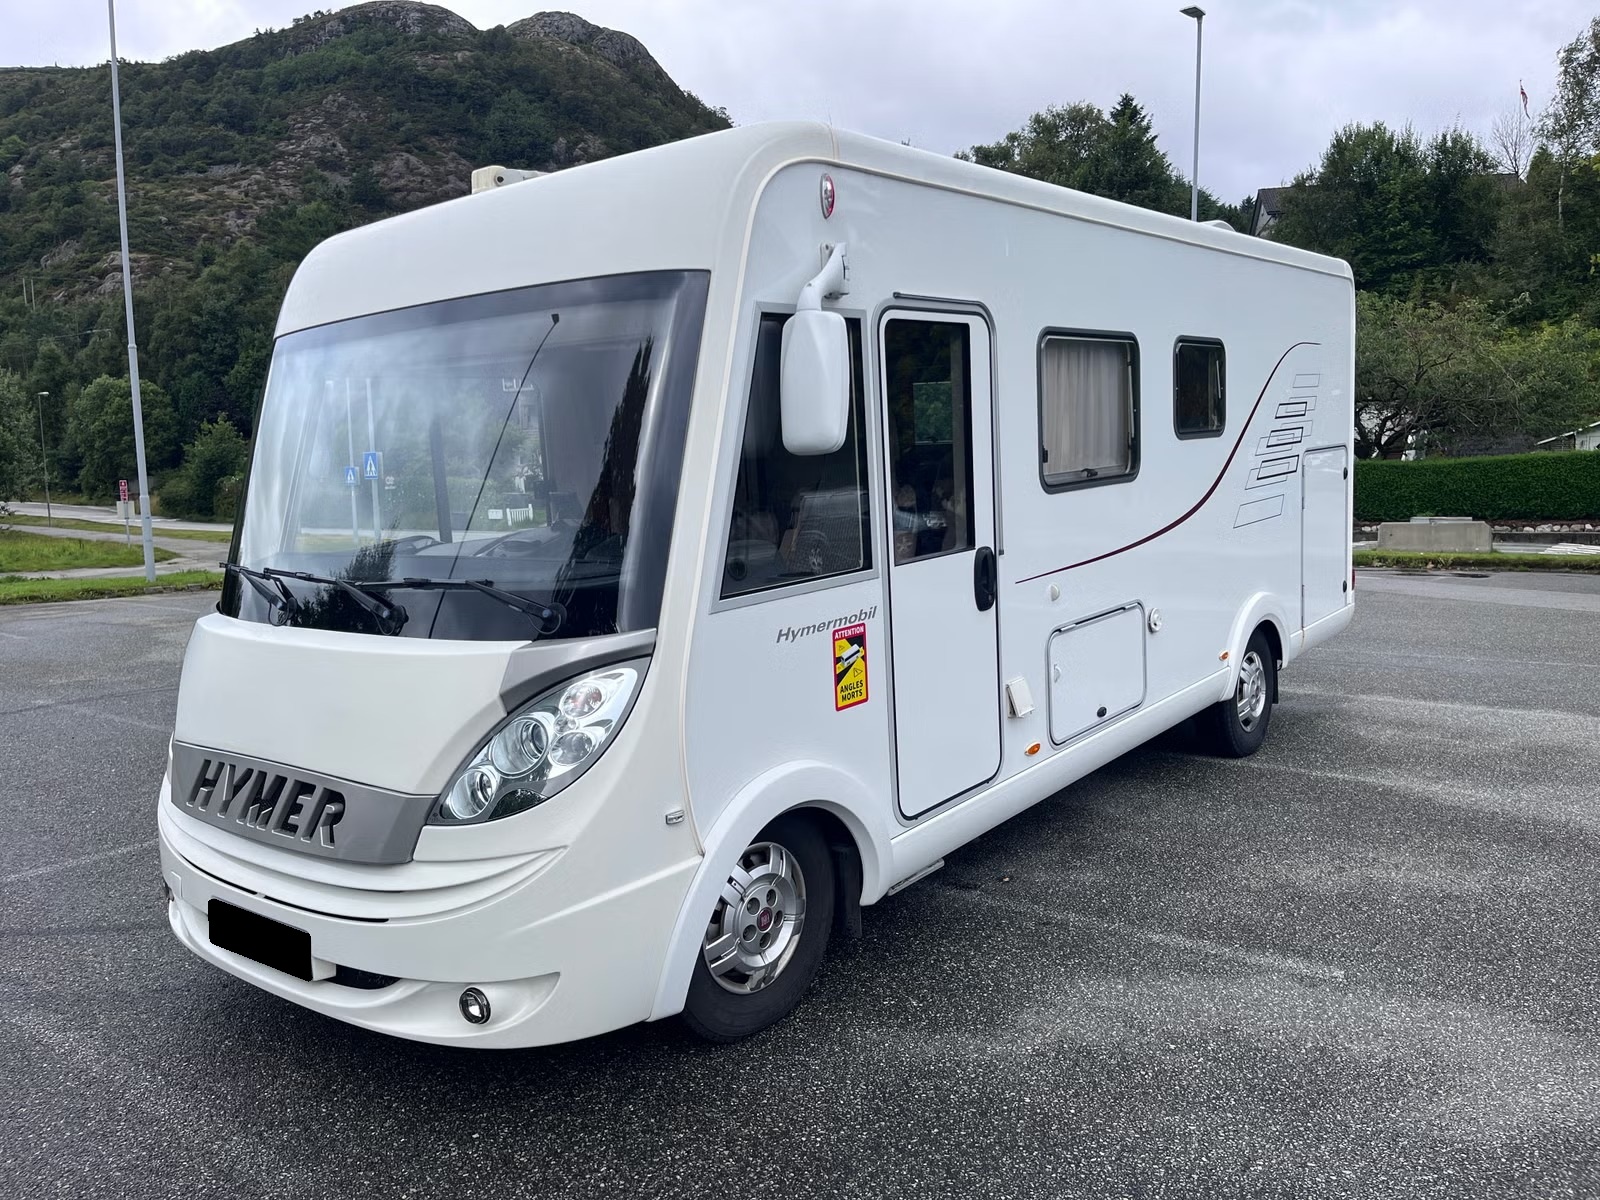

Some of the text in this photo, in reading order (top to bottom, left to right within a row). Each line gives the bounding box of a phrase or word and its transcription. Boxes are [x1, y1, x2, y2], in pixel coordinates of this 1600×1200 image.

[776, 606, 877, 643] Hymermobil
[835, 625, 864, 640] ATTENTION
[840, 680, 864, 694] ANGLES
[841, 689, 863, 702] MORTS
[186, 758, 346, 849] HYMER
